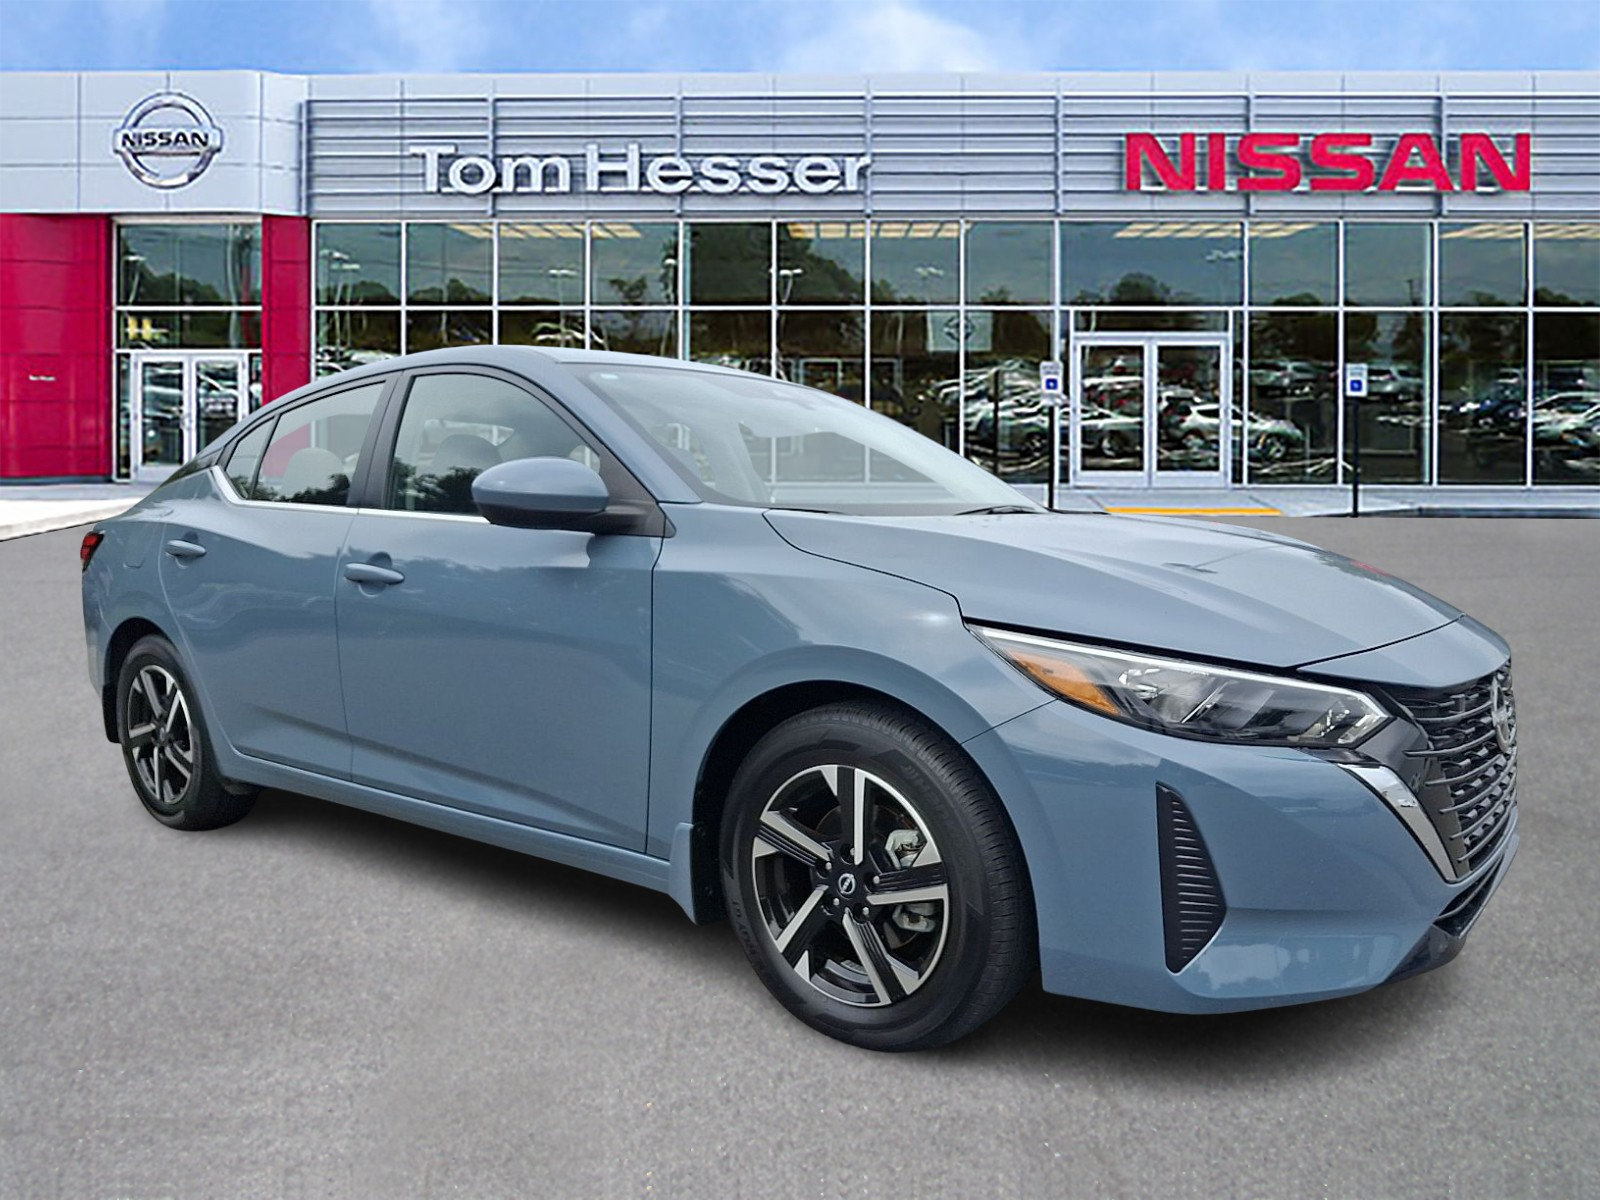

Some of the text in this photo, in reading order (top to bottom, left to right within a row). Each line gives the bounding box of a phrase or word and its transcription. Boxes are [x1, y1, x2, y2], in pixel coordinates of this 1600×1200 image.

[122, 131, 209, 147] NISSAN
[1125, 132, 1531, 192] NISSAN
[409, 143, 871, 195] Tom Hesser
